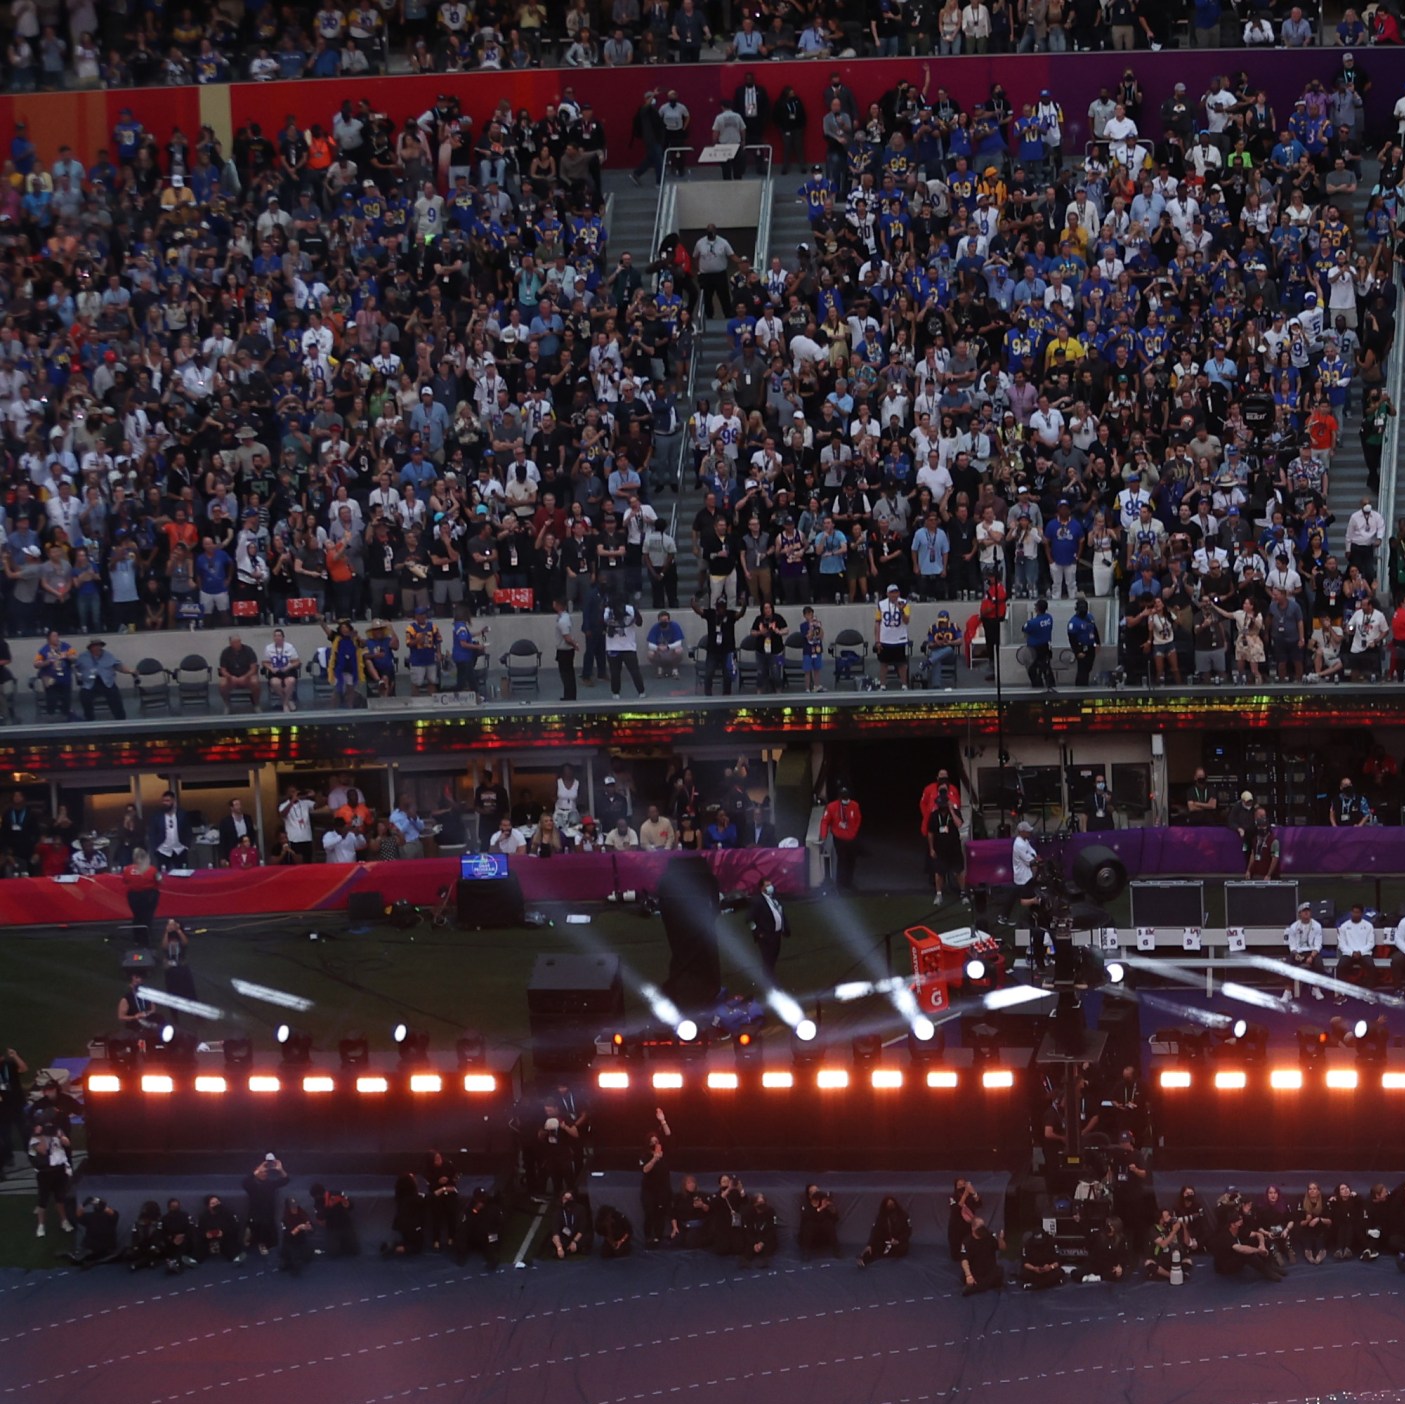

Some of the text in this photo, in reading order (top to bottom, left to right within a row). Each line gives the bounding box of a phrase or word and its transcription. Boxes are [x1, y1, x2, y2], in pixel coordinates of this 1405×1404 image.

[952, 180, 971, 198] 99
[427, 207, 437, 223] 9
[1312, 321, 1321, 335] 5
[1294, 343, 1303, 357] 9
[1206, 395, 1213, 413] 1
[722, 428, 737, 445] 99
[360, 457, 369, 472] 9
[882, 611, 902, 627] 99
[1040, 618, 1051, 627] CSC
[931, 990, 942, 1006] G
